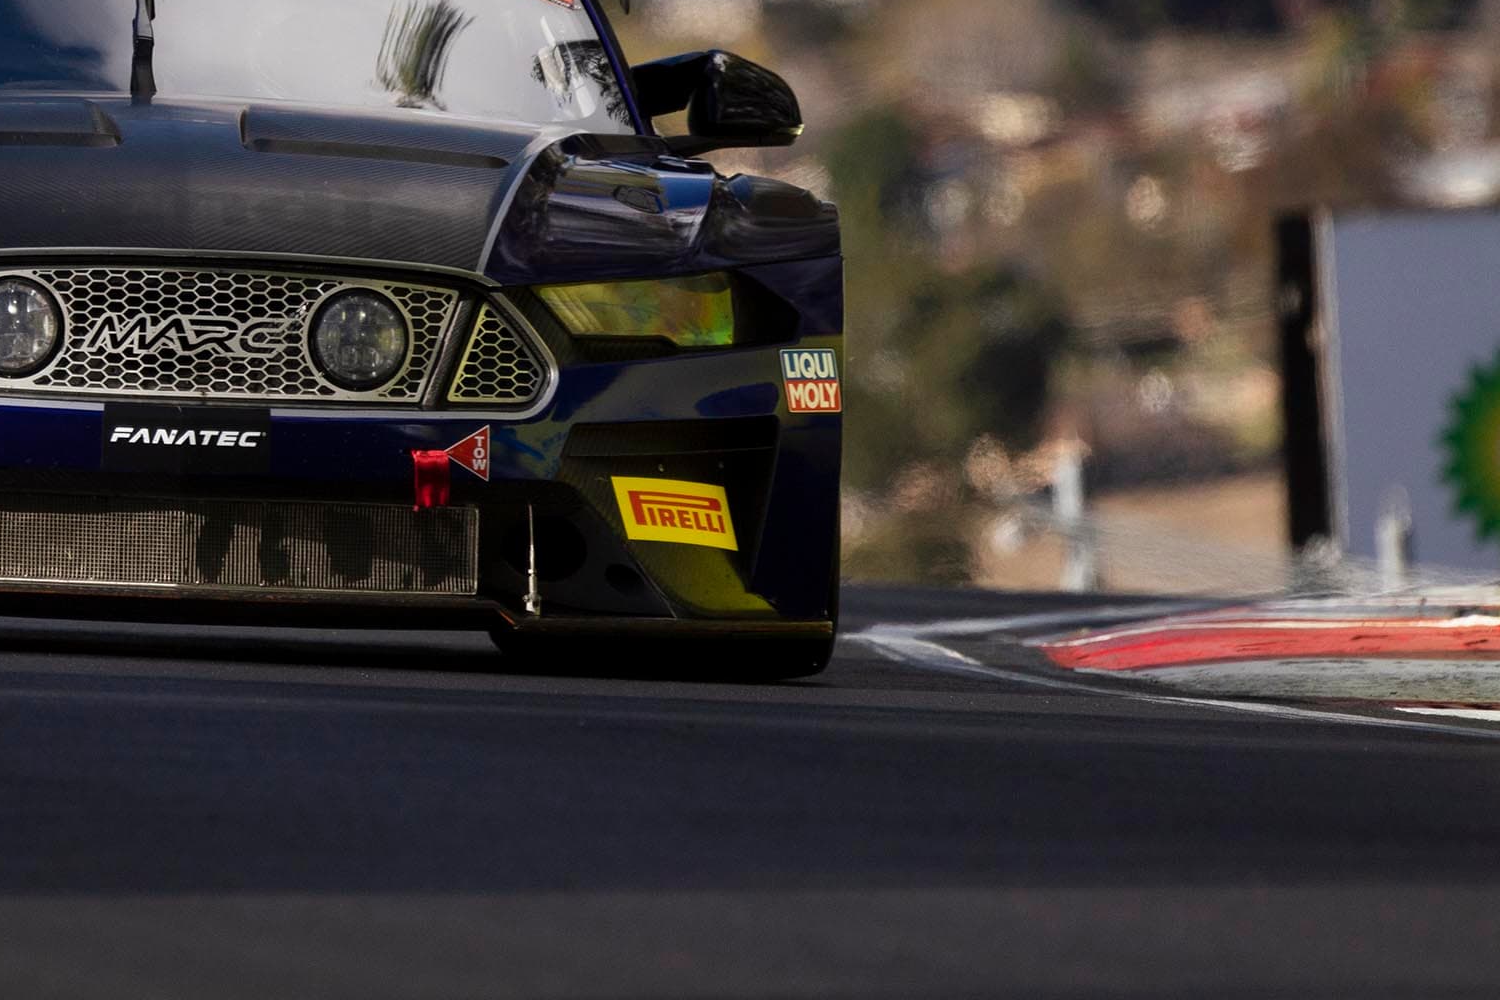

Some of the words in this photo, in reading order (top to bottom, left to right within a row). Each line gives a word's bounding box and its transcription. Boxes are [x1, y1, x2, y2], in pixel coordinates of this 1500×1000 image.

[85, 313, 284, 356] MARC
[783, 352, 835, 379] LIQUI
[788, 382, 838, 409] MOLY
[110, 427, 261, 448] FANATEC
[472, 435, 487, 470] TOW
[627, 490, 726, 534] PIRELLI
